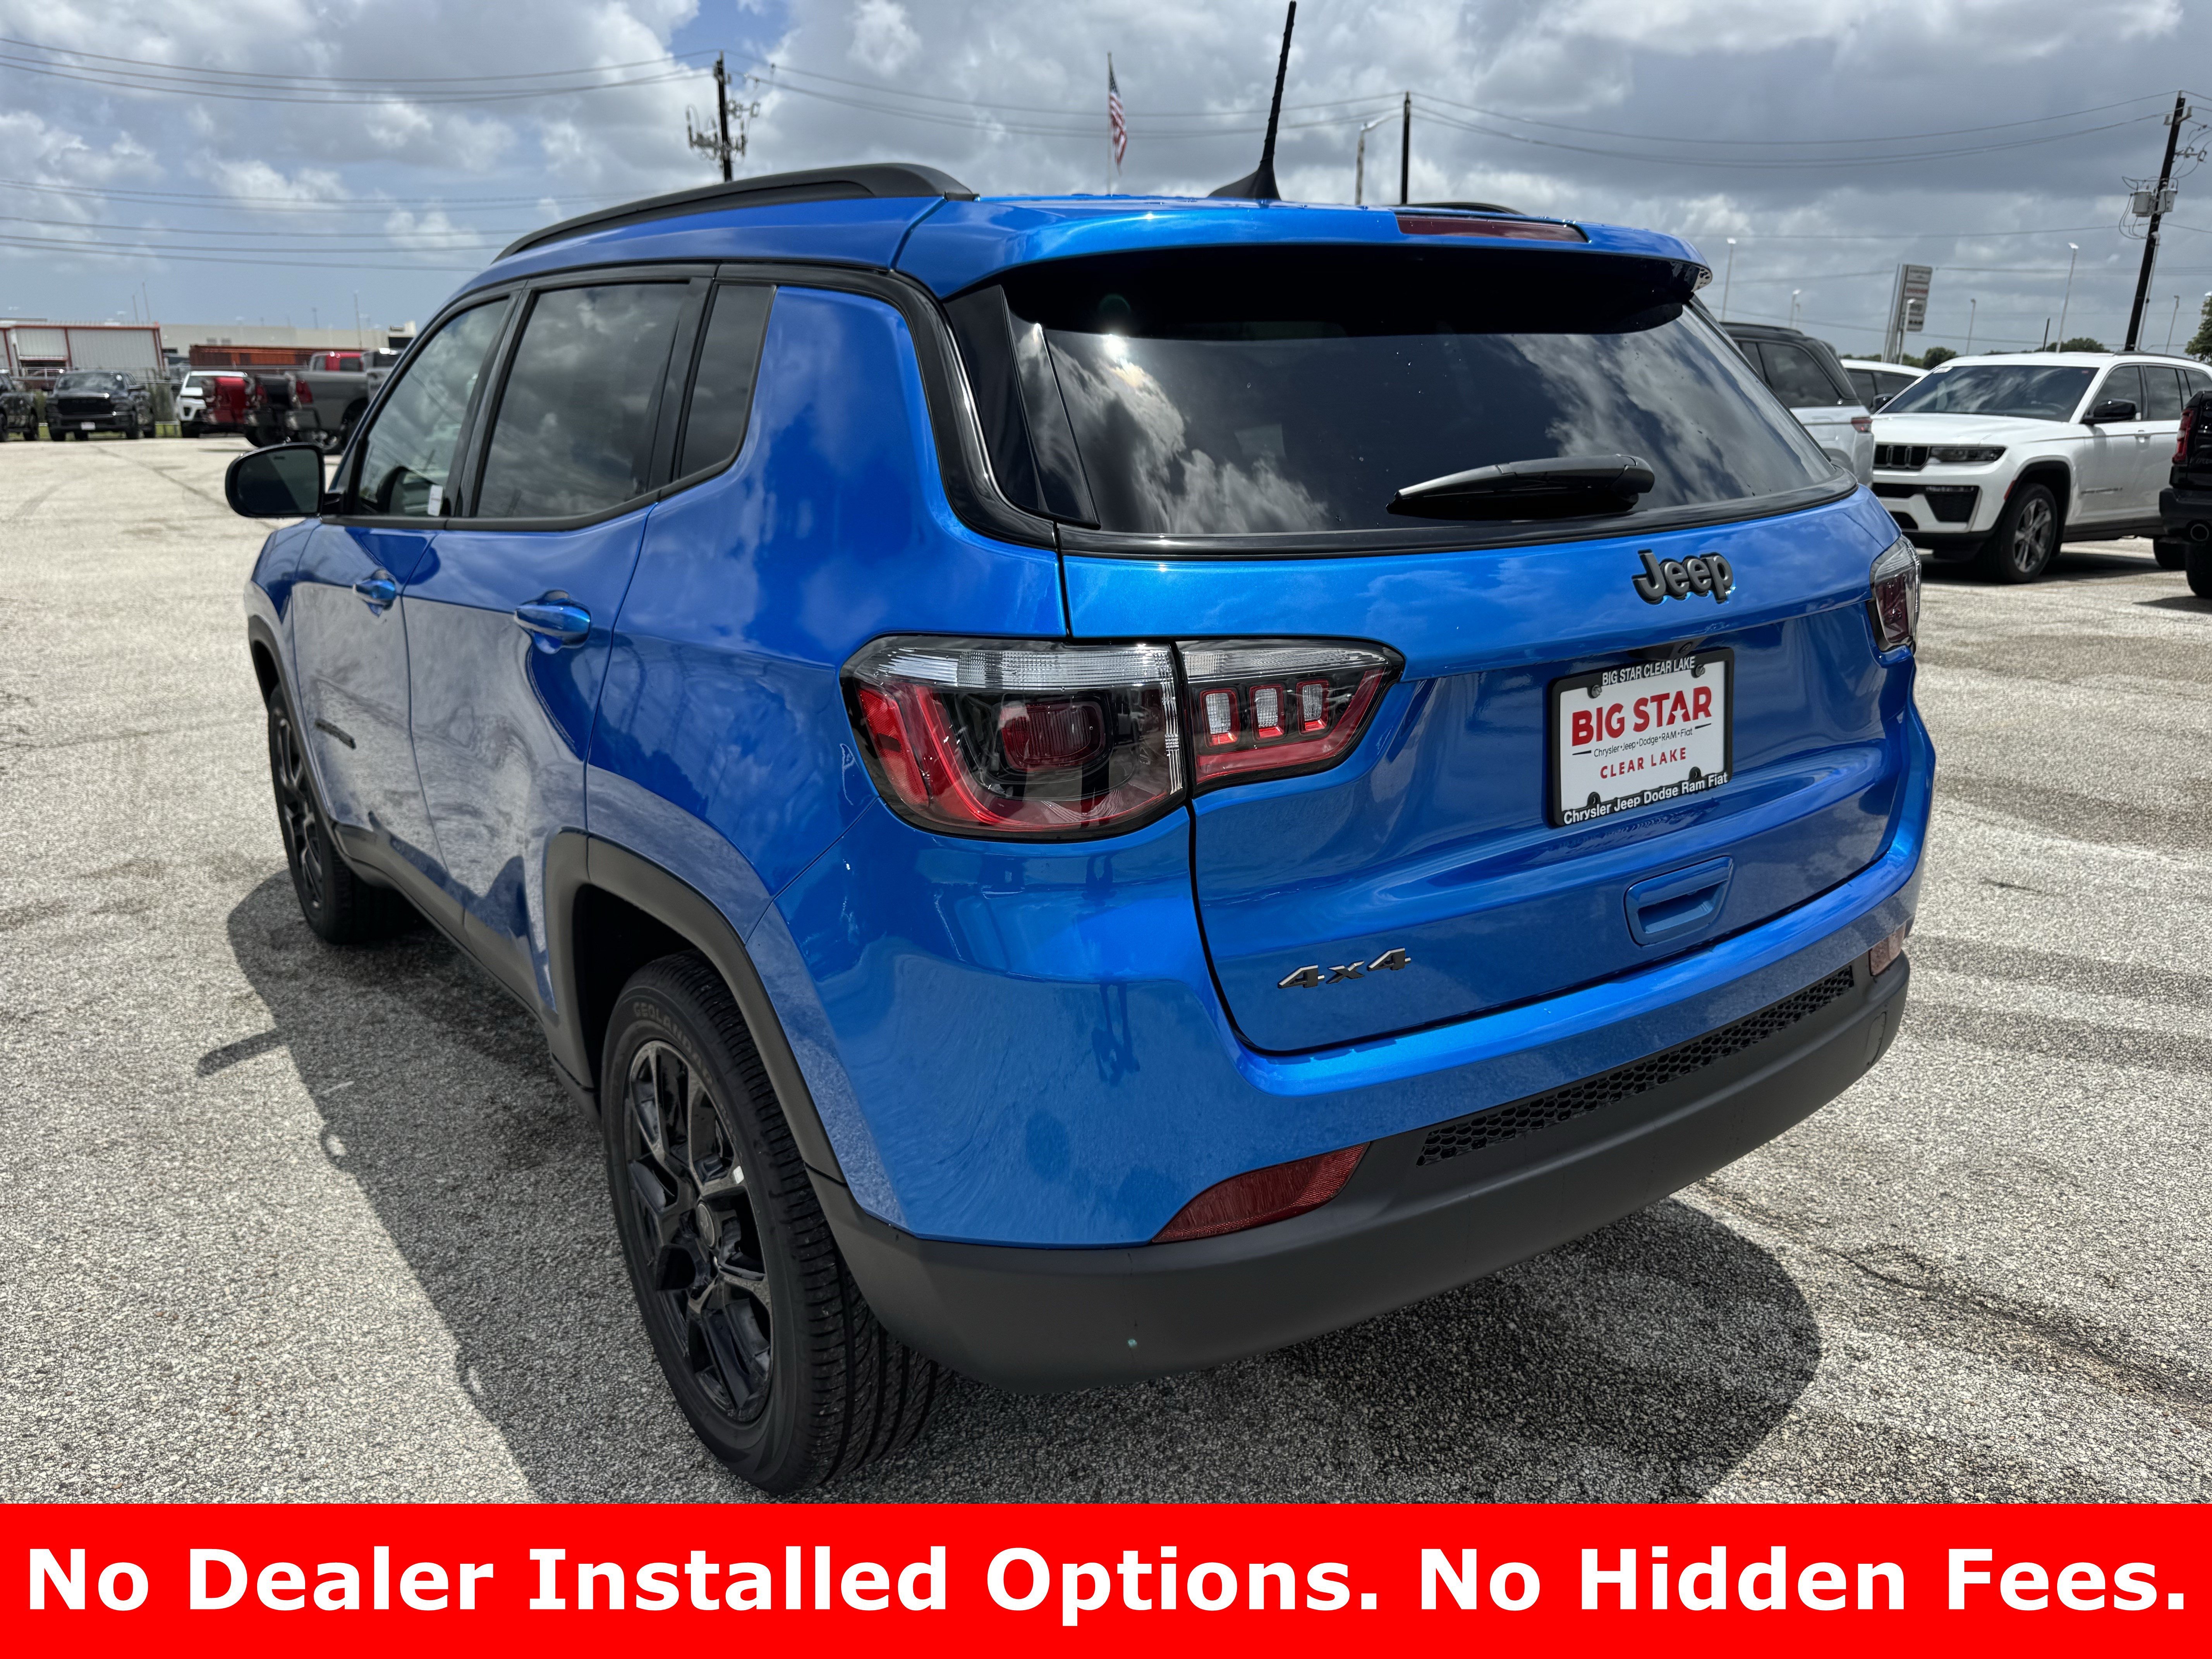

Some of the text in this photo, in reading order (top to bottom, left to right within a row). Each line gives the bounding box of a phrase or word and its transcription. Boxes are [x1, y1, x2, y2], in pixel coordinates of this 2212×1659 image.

[1631, 548, 1733, 605] Jeep
[1602, 656, 1696, 685] BIG STAR CLEAR LAKE
[1572, 686, 1712, 746] BIG STAR
[1600, 747, 1686, 779] CLEAR LAKE
[1563, 772, 1728, 824] Chrysler Jeep Dodge Ram Fiat
